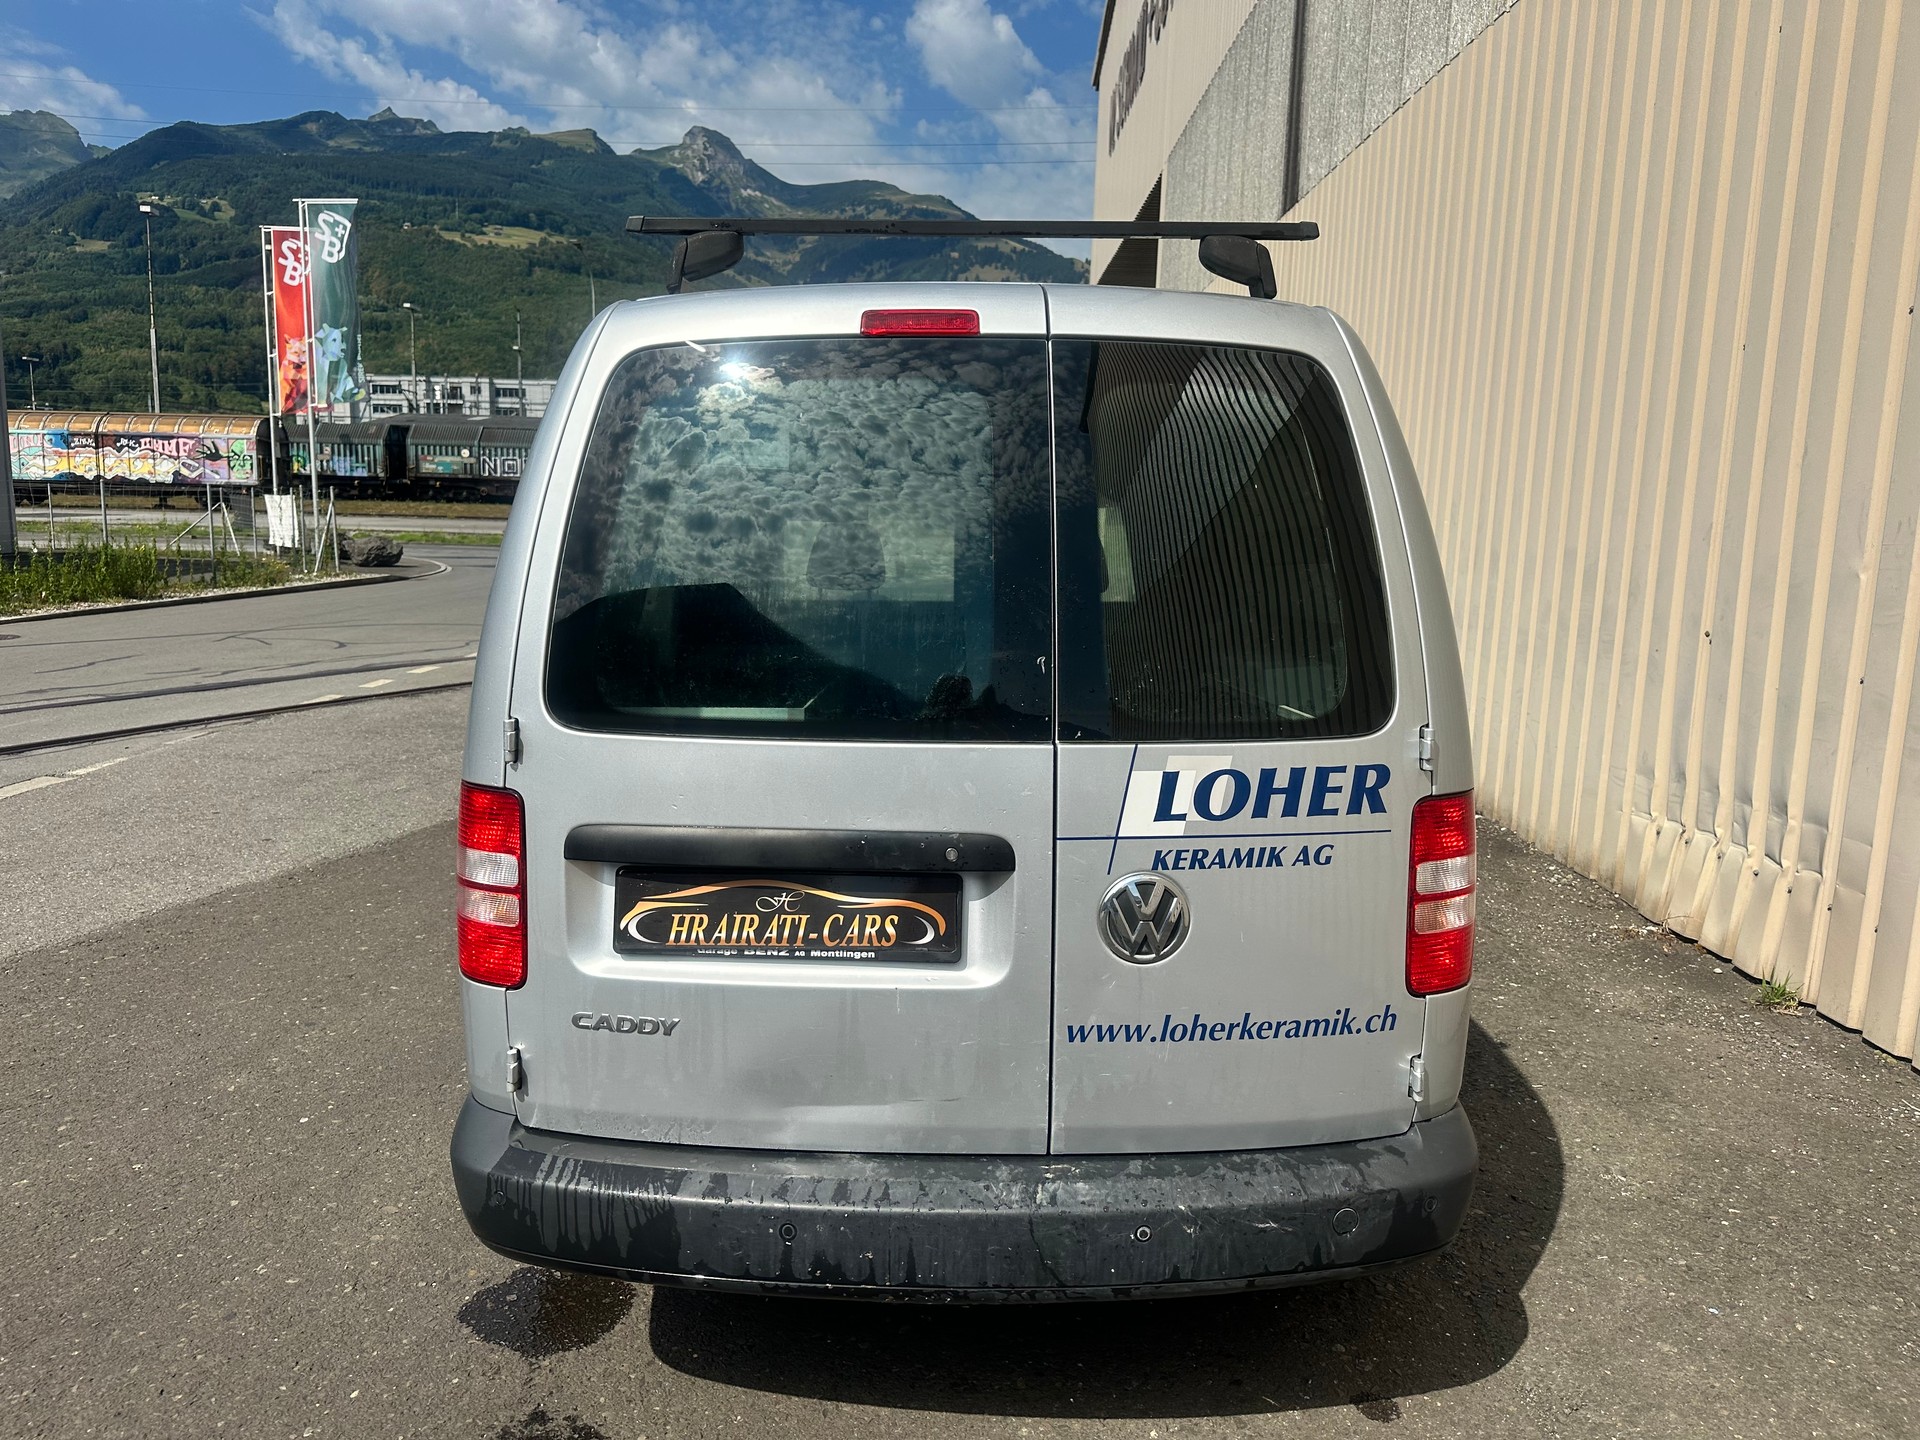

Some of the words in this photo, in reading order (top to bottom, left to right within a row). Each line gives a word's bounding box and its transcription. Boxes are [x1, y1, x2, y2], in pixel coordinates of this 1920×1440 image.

[1153, 763, 1391, 822] LOHER
[1151, 846, 1287, 871] KERAMIK
[1291, 844, 1334, 867] AG
[810, 950, 876, 959] Montlingen
[571, 1011, 681, 1036] CADDY
[1066, 1005, 1397, 1043] www.loherkeramik.ch
